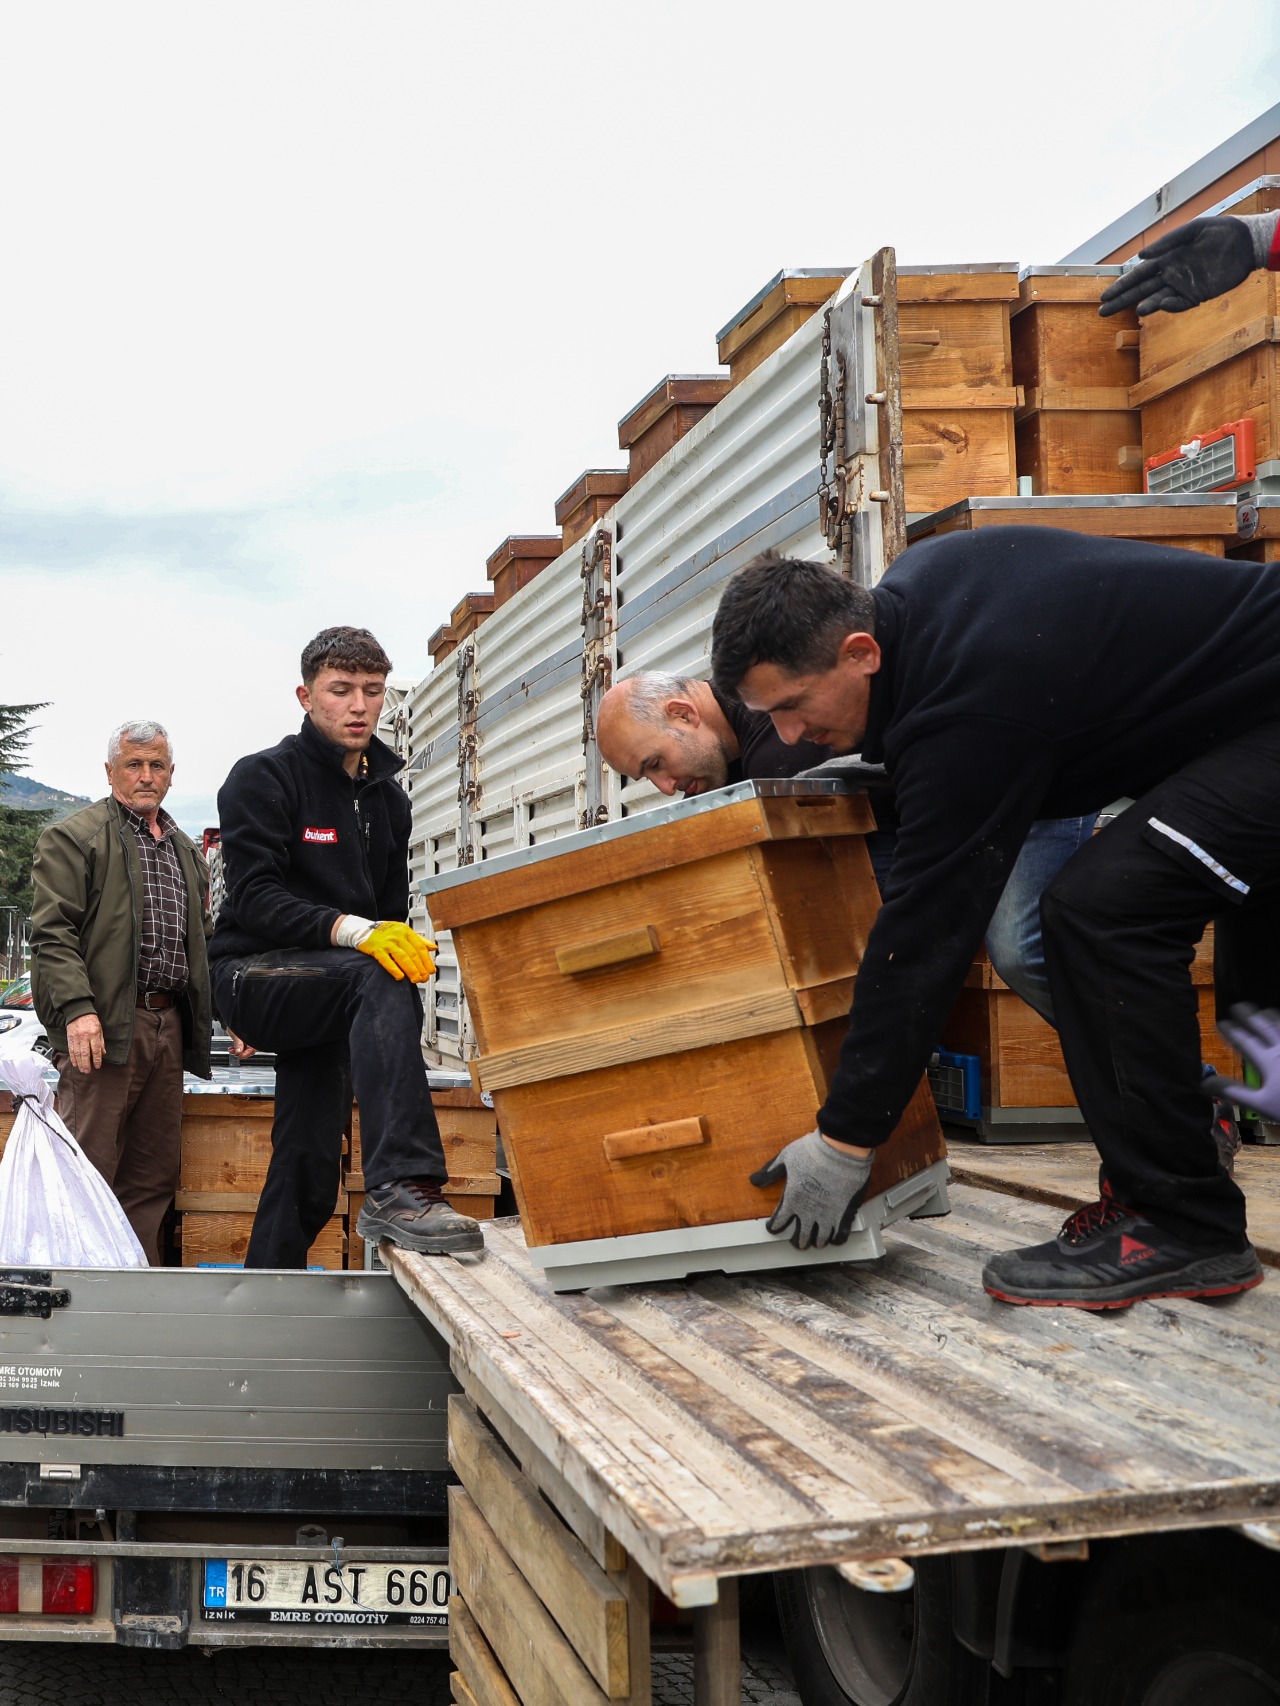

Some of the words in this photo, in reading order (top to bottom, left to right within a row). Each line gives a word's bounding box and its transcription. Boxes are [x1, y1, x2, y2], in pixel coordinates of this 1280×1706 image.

[18, 1366, 63, 1377] OTOMOTİV
[40, 1379, 60, 1388] İZNİK
[231, 1563, 266, 1602] 16
[301, 1564, 366, 1604] AST
[386, 1568, 450, 1606] 660
[209, 1586, 225, 1598] TR
[204, 1610, 236, 1619] İZNİK
[270, 1611, 311, 1622] EMRE
[410, 1615, 425, 1624] 0224
[426, 1616, 438, 1624] 757
[438, 1616, 447, 1625] 49
